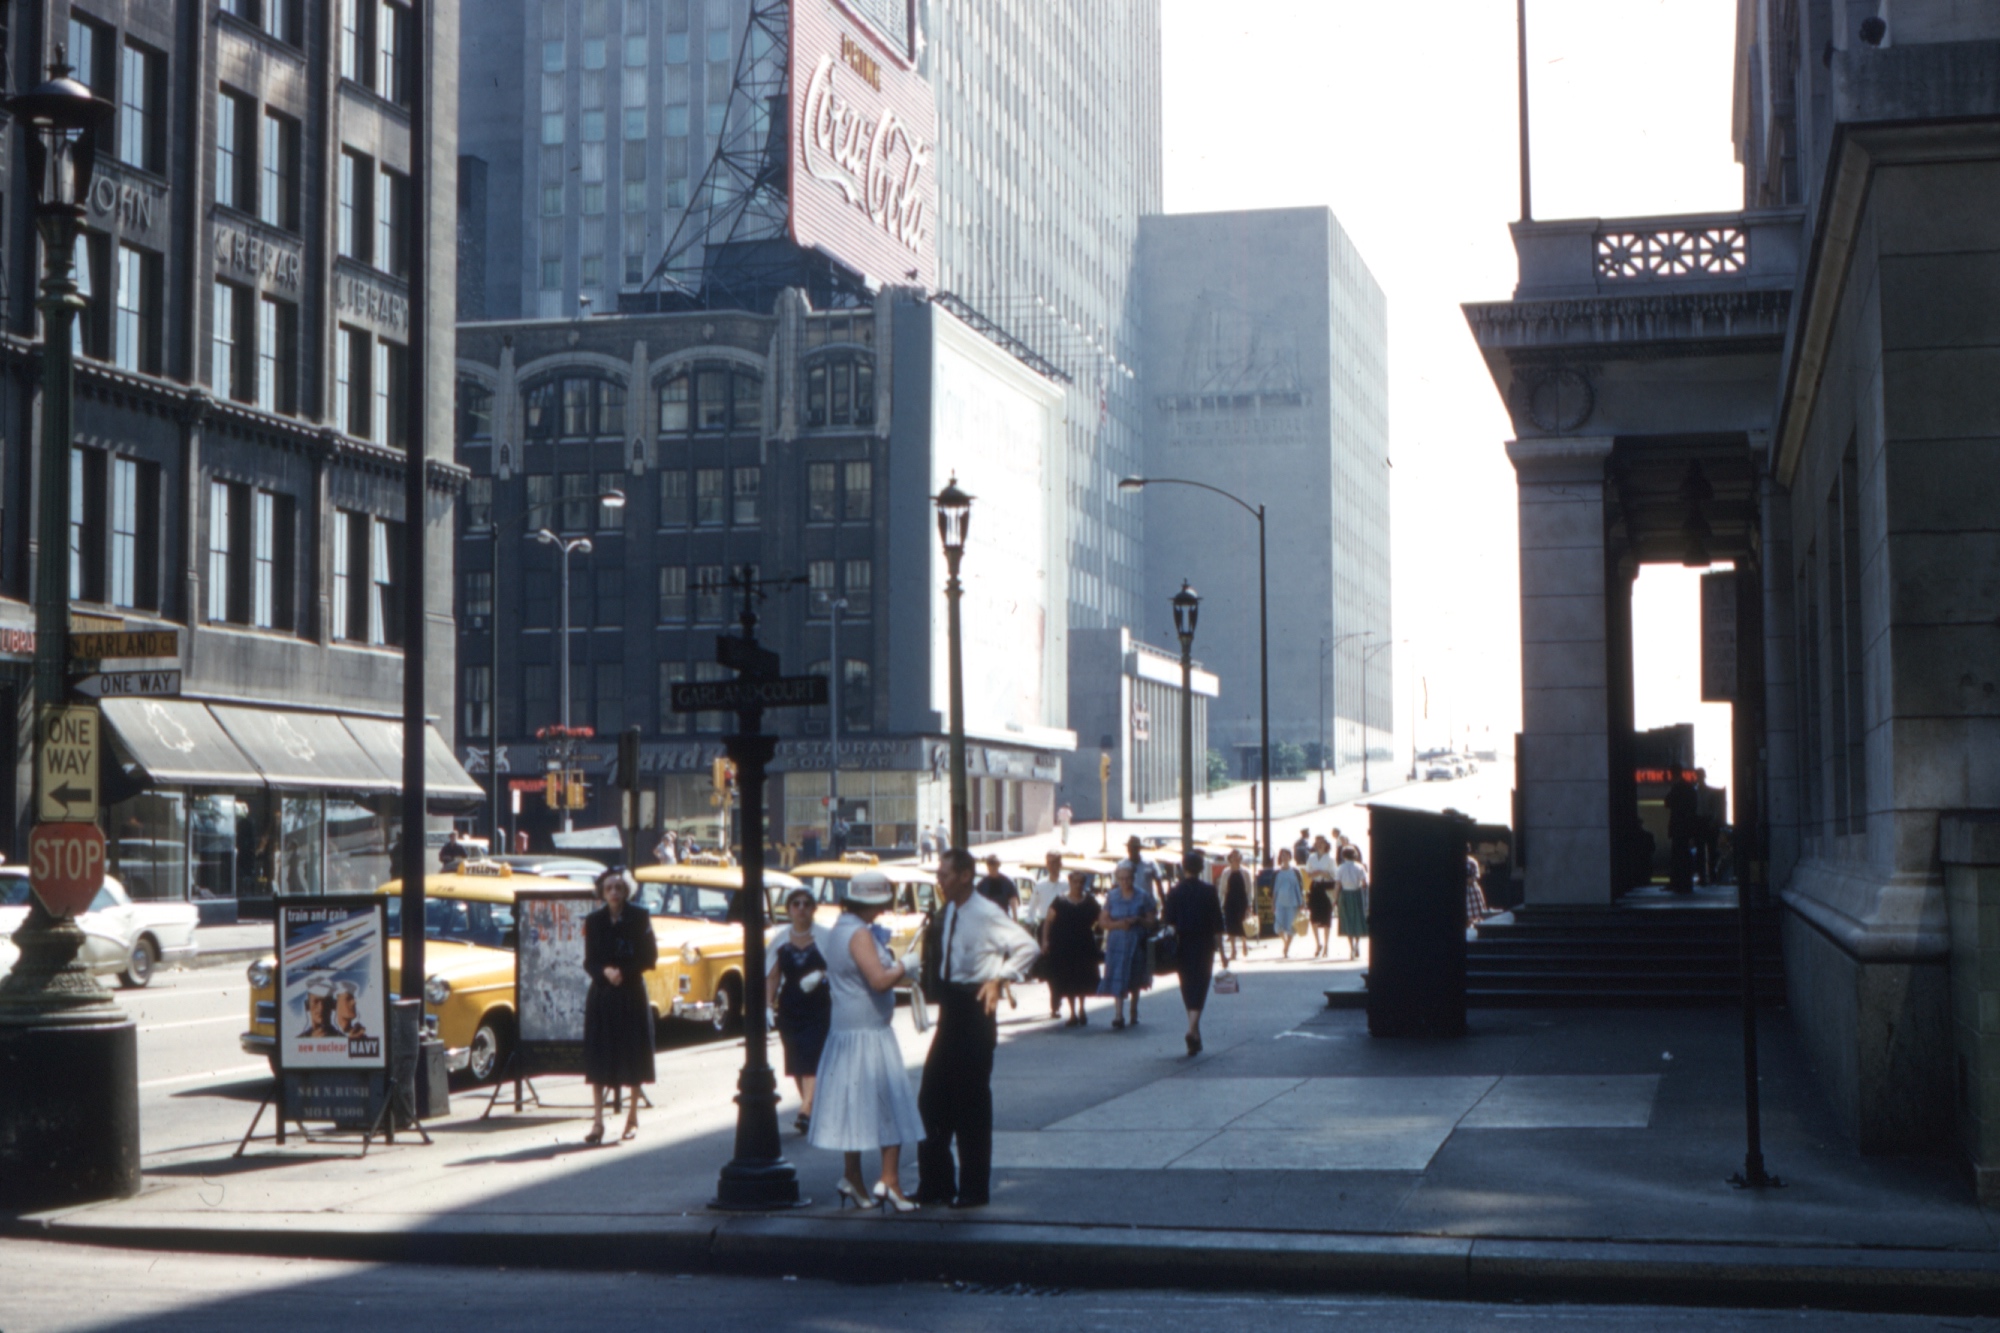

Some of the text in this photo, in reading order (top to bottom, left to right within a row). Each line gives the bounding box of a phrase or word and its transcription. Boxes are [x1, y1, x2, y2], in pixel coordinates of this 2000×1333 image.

[803, 54, 927, 253] Coca-Cola
[215, 226, 300, 286] CRERAR
[85, 634, 157, 657] GARLAND
[162, 637, 175, 651] CT
[101, 674, 171, 694] ONE WAY
[761, 680, 816, 701] COURT
[48, 716, 91, 745] ONE
[46, 748, 92, 775] WAY
[788, 757, 834, 769] SOD
[34, 838, 101, 880] STOP
[465, 865, 500, 876] YELLOW
[288, 908, 348, 923] train and gain
[298, 1040, 379, 1054] new nuclear NAVY
